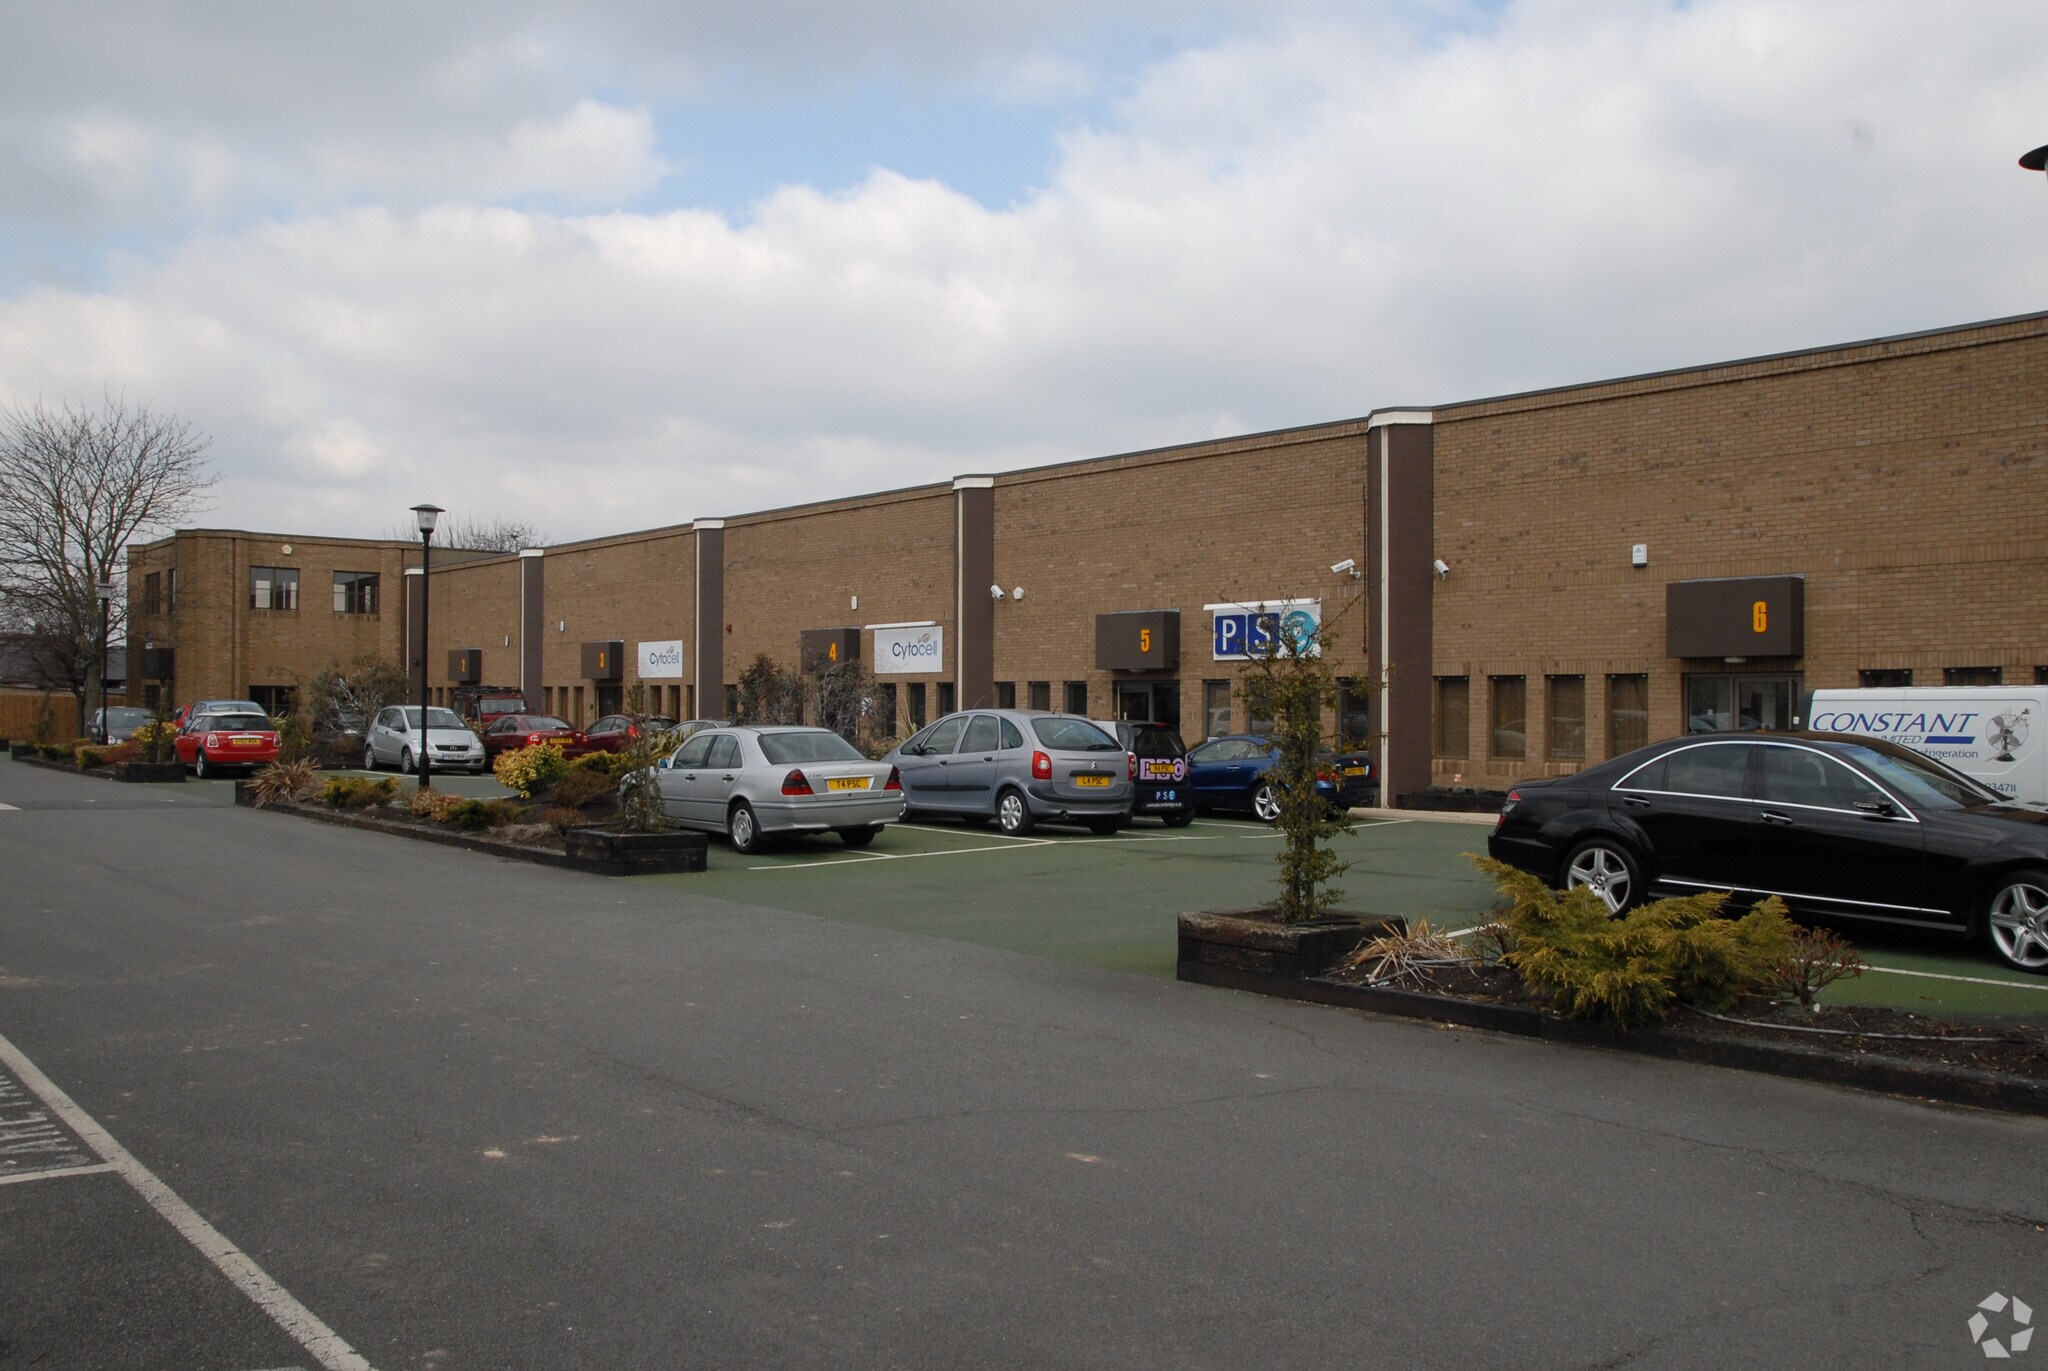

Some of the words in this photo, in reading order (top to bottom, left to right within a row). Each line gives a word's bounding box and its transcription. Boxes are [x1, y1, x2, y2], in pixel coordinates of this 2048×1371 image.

[1753, 601, 1767, 633] 6
[892, 640, 938, 660] Cytocell
[1140, 628, 1150, 653] 5
[649, 651, 680, 667] Cytocell
[829, 642, 837, 661] 4
[1813, 712, 1979, 733] CONSTANT
[836, 780, 846, 789] T4
[847, 779, 861, 788] PSC
[1091, 776, 1103, 784] PSC
